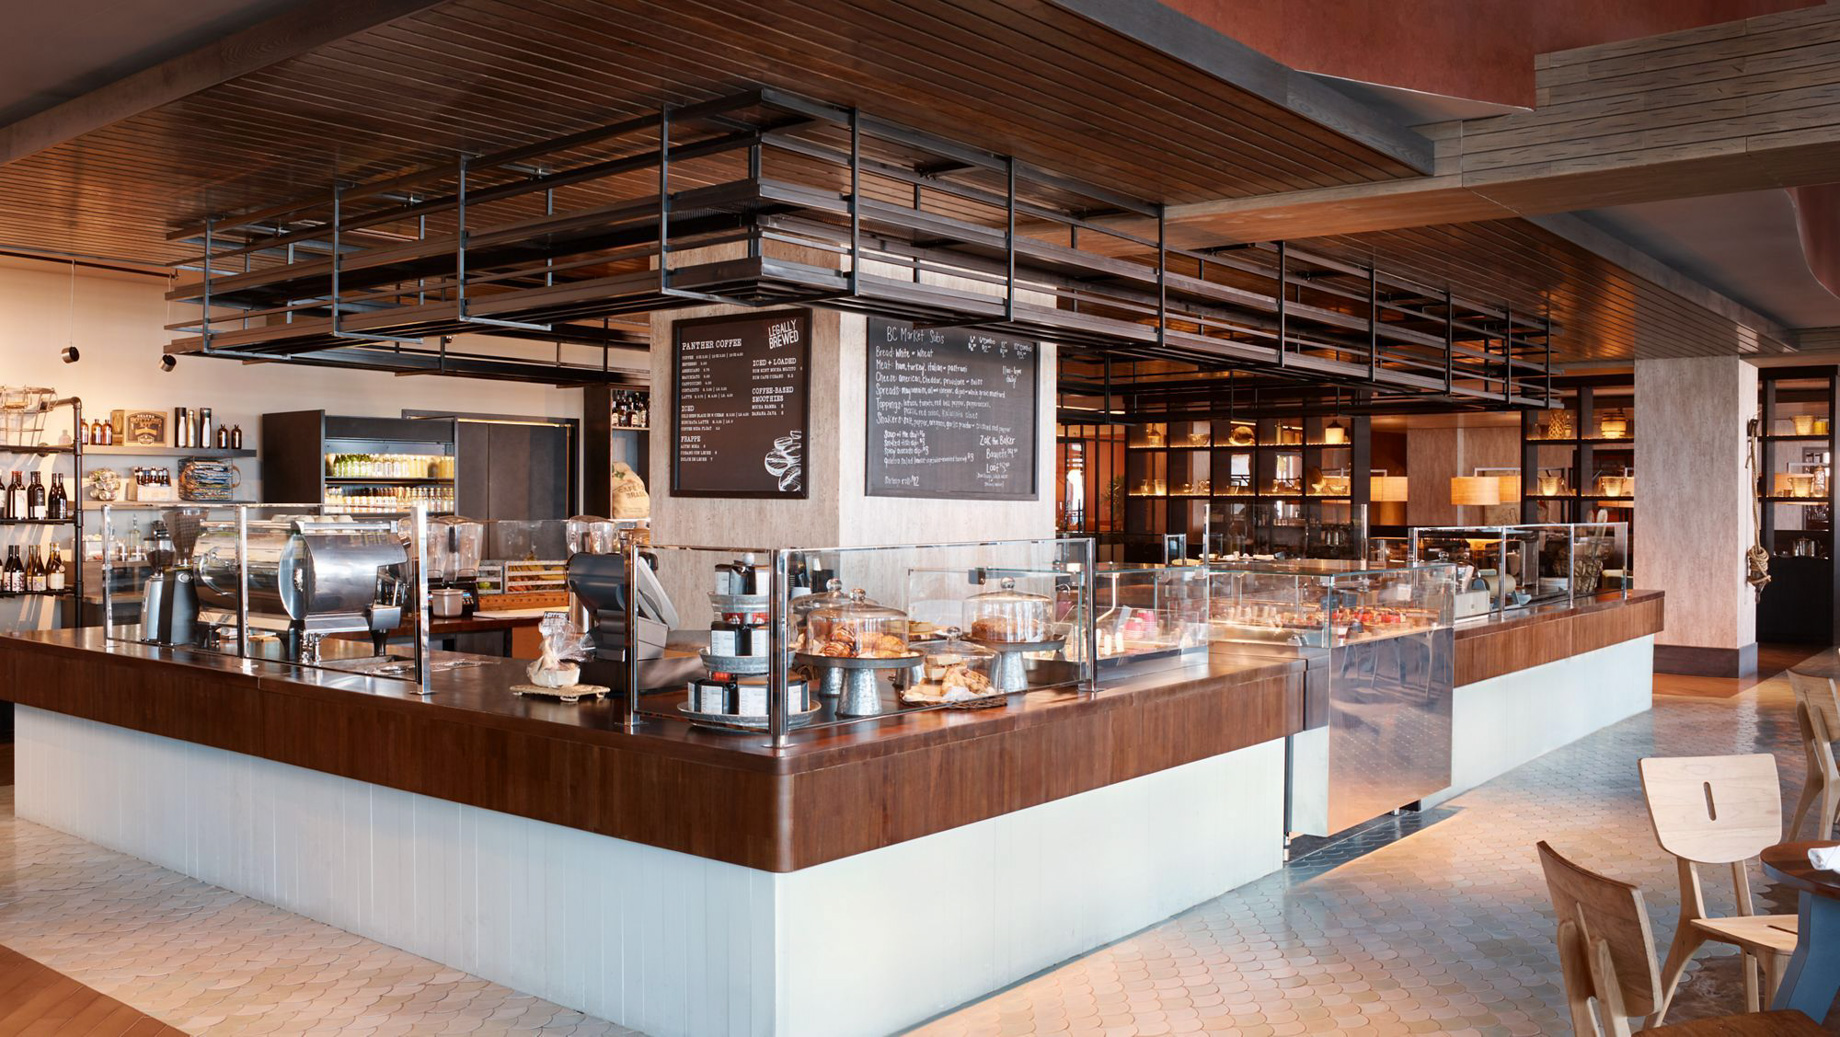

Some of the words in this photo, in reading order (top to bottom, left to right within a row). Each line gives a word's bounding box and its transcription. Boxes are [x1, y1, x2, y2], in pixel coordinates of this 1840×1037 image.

[768, 319, 797, 337] LEGALLY
[887, 326, 898, 342] BC
[901, 327, 924, 342] Market
[930, 330, 944, 344] Subs
[682, 341, 714, 350] PANTHER
[716, 338, 742, 348] COFFEE
[768, 330, 799, 350] BREWED
[752, 386, 794, 394] COFFEE-BASED
